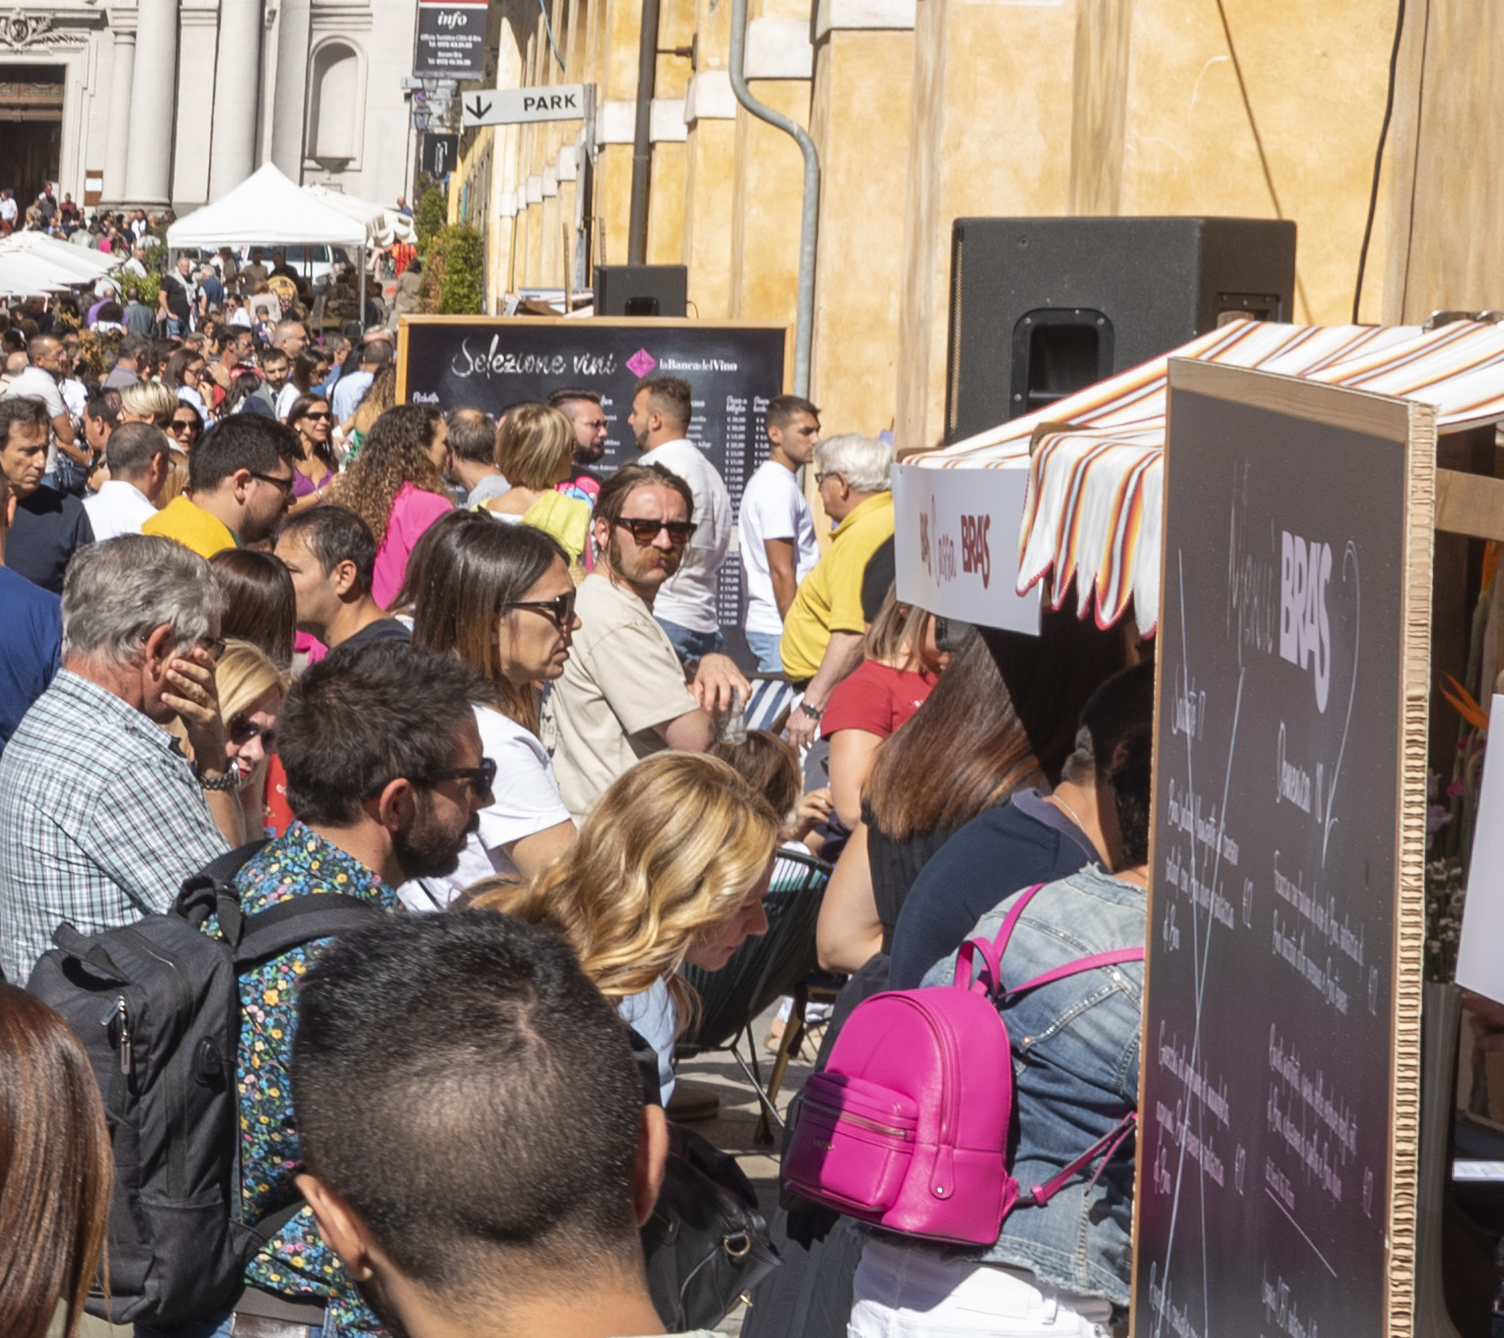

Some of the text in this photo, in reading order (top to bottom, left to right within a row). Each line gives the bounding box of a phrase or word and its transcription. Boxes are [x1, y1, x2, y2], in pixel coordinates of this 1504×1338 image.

[437, 11, 468, 30] info
[523, 93, 577, 112] PARK
[450, 333, 618, 379] Selezione vini
